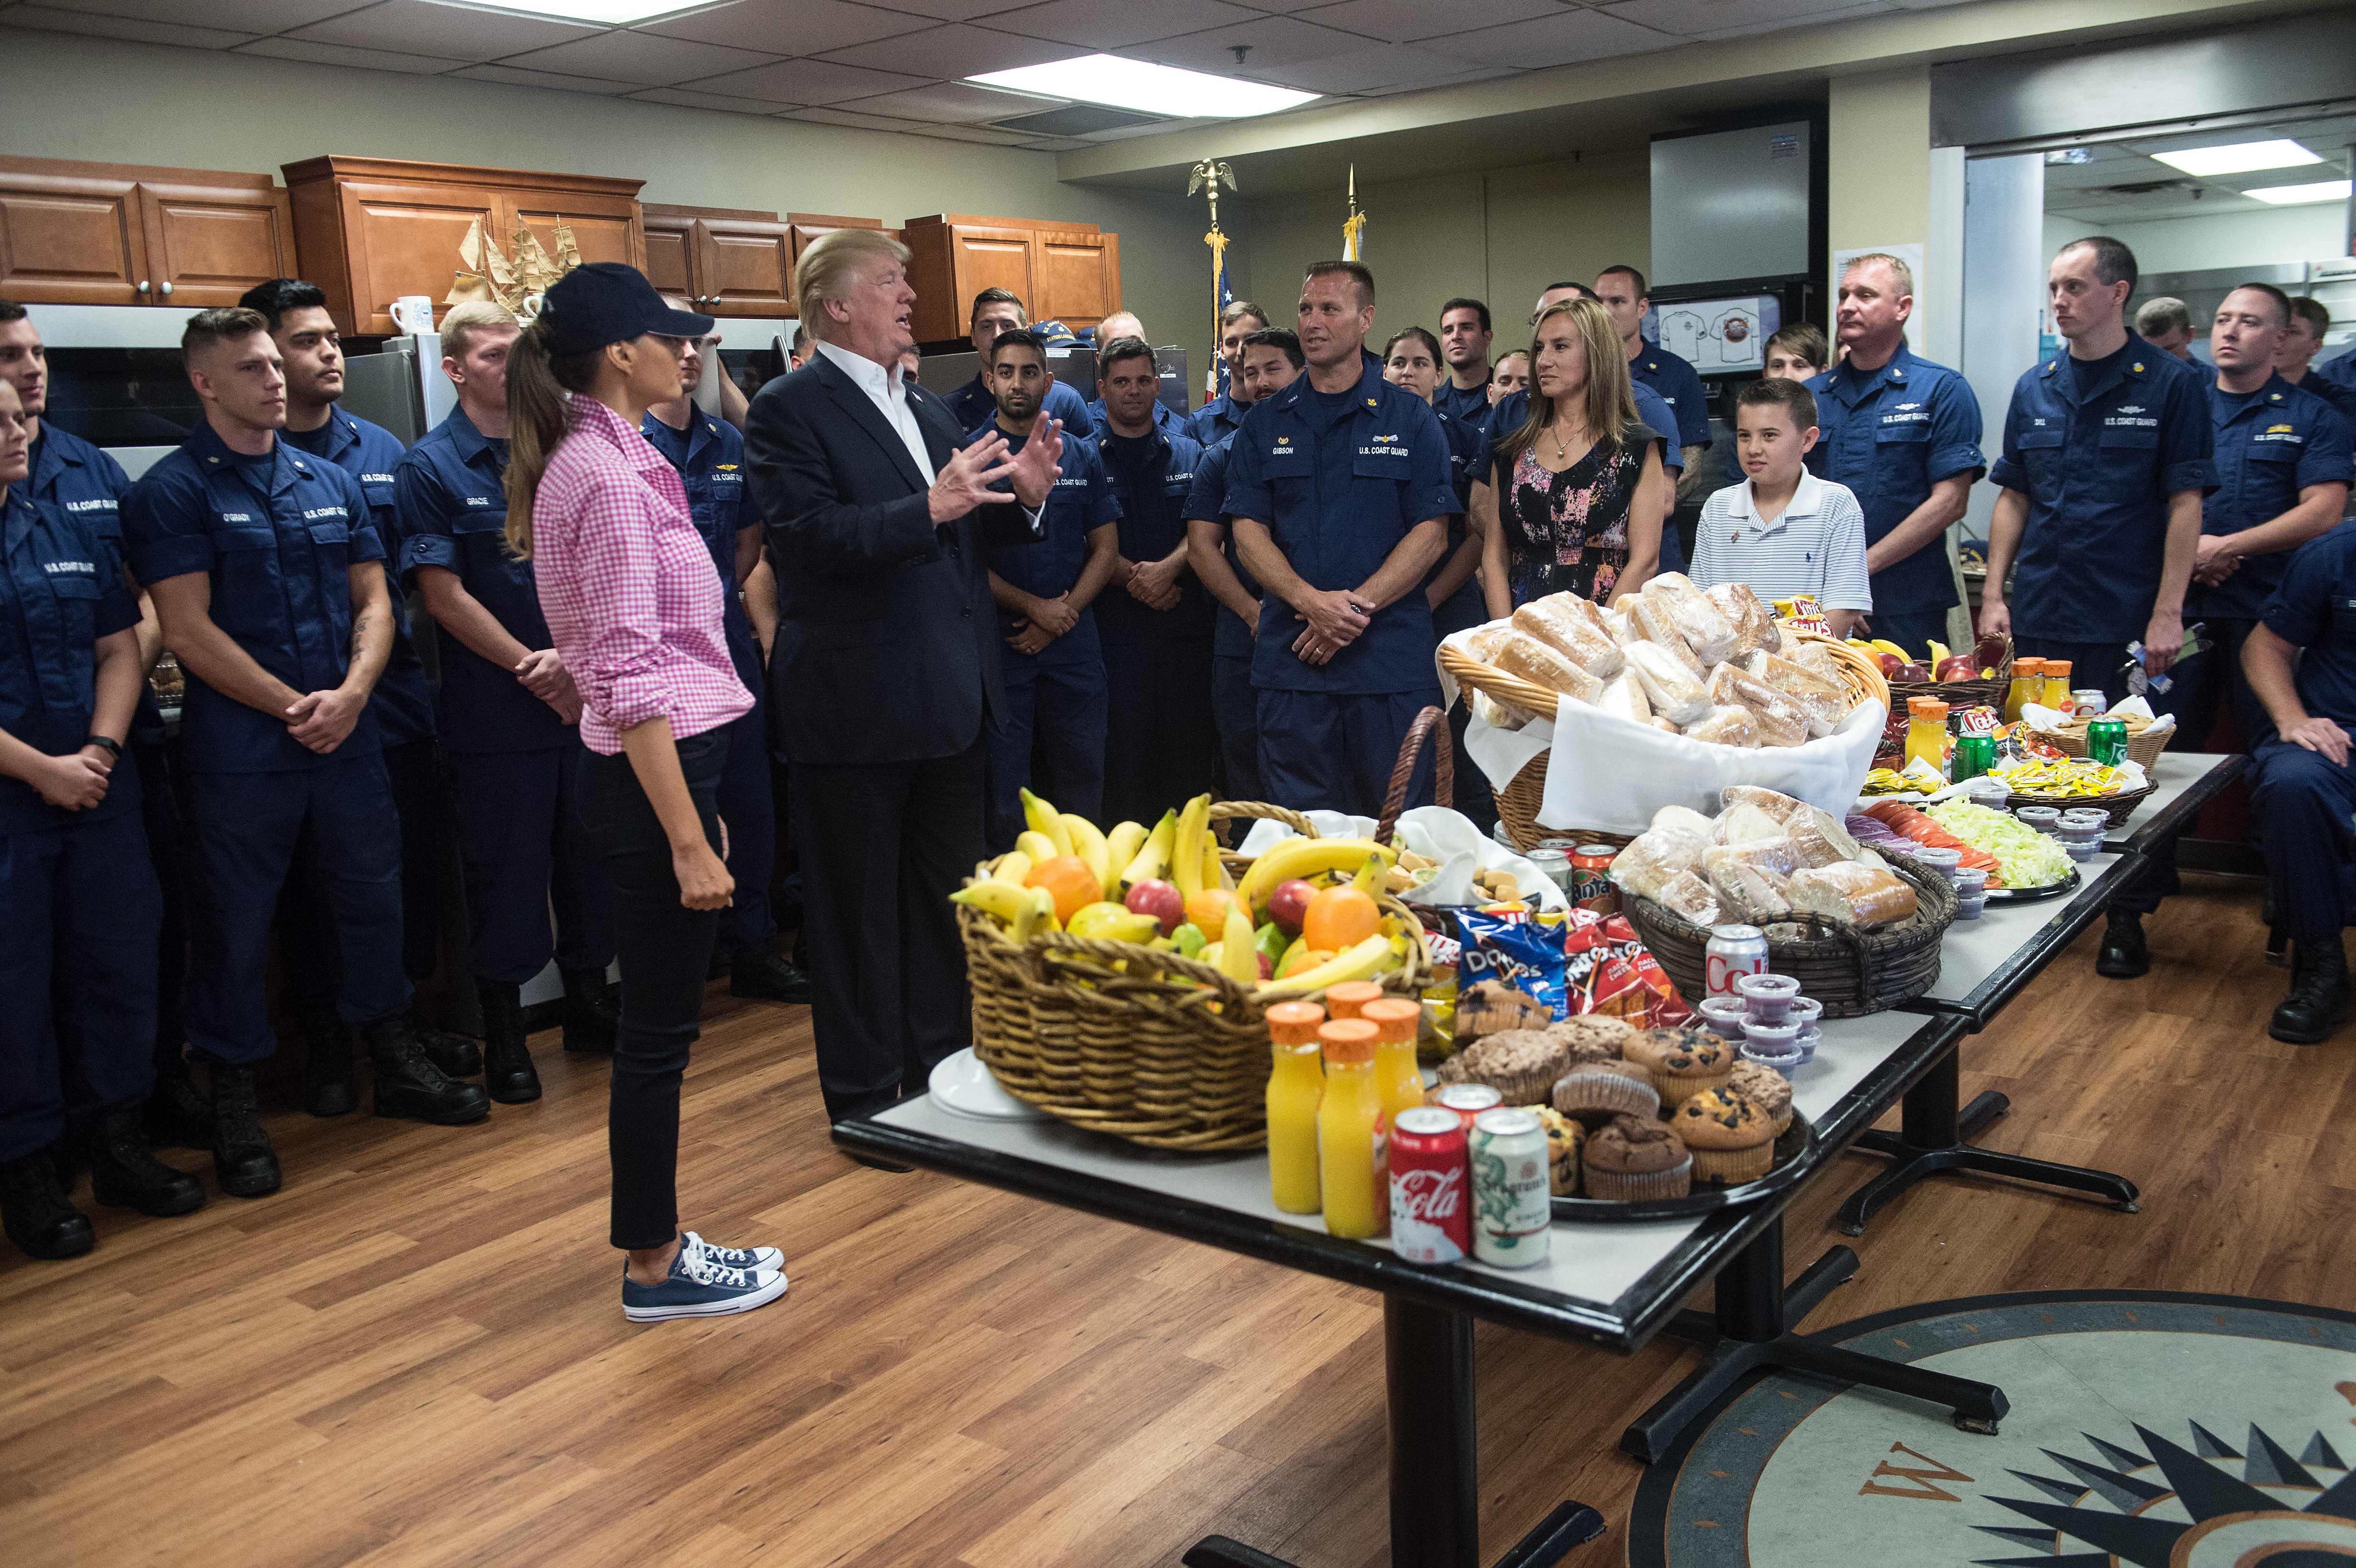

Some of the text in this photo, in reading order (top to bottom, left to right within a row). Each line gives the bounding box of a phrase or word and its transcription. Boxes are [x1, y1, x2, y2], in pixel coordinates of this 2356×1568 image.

[2104, 417, 2158, 426] U.S. COAST GUARD
[1371, 446, 1390, 455] COAST
[1390, 446, 1408, 457] GUARD
[80, 501, 102, 511] COAST
[467, 497, 489, 505] GRACIE
[304, 510, 318, 519] U.S.
[317, 507, 337, 517] COAST
[1574, 877, 1612, 902] anta
[1858, 1441, 1975, 1503] W
